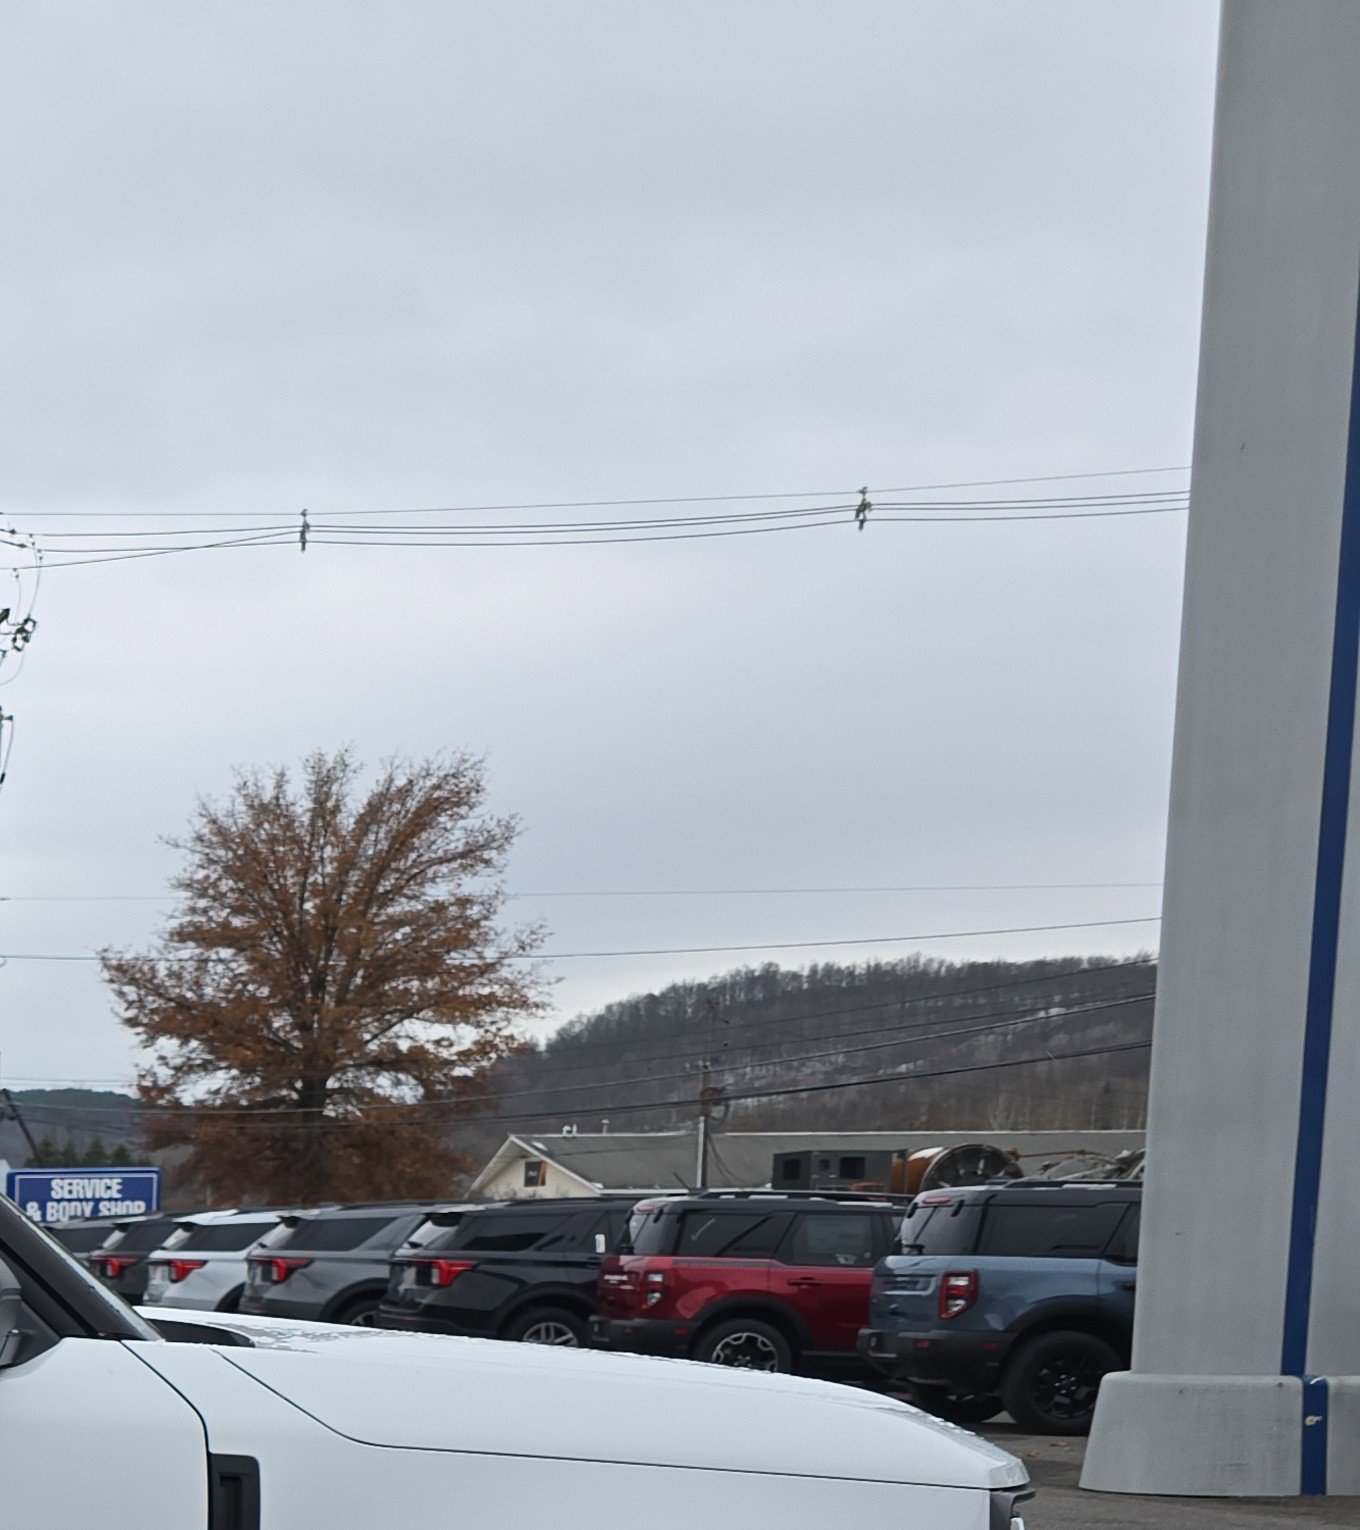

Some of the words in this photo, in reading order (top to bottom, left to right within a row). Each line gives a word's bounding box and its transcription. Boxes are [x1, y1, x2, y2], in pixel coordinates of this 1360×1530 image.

[51, 1178, 122, 1199] SERVICE
[26, 1202, 42, 1221] &
[46, 1202, 93, 1221] BODY
[98, 1201, 146, 1216] SHOP
